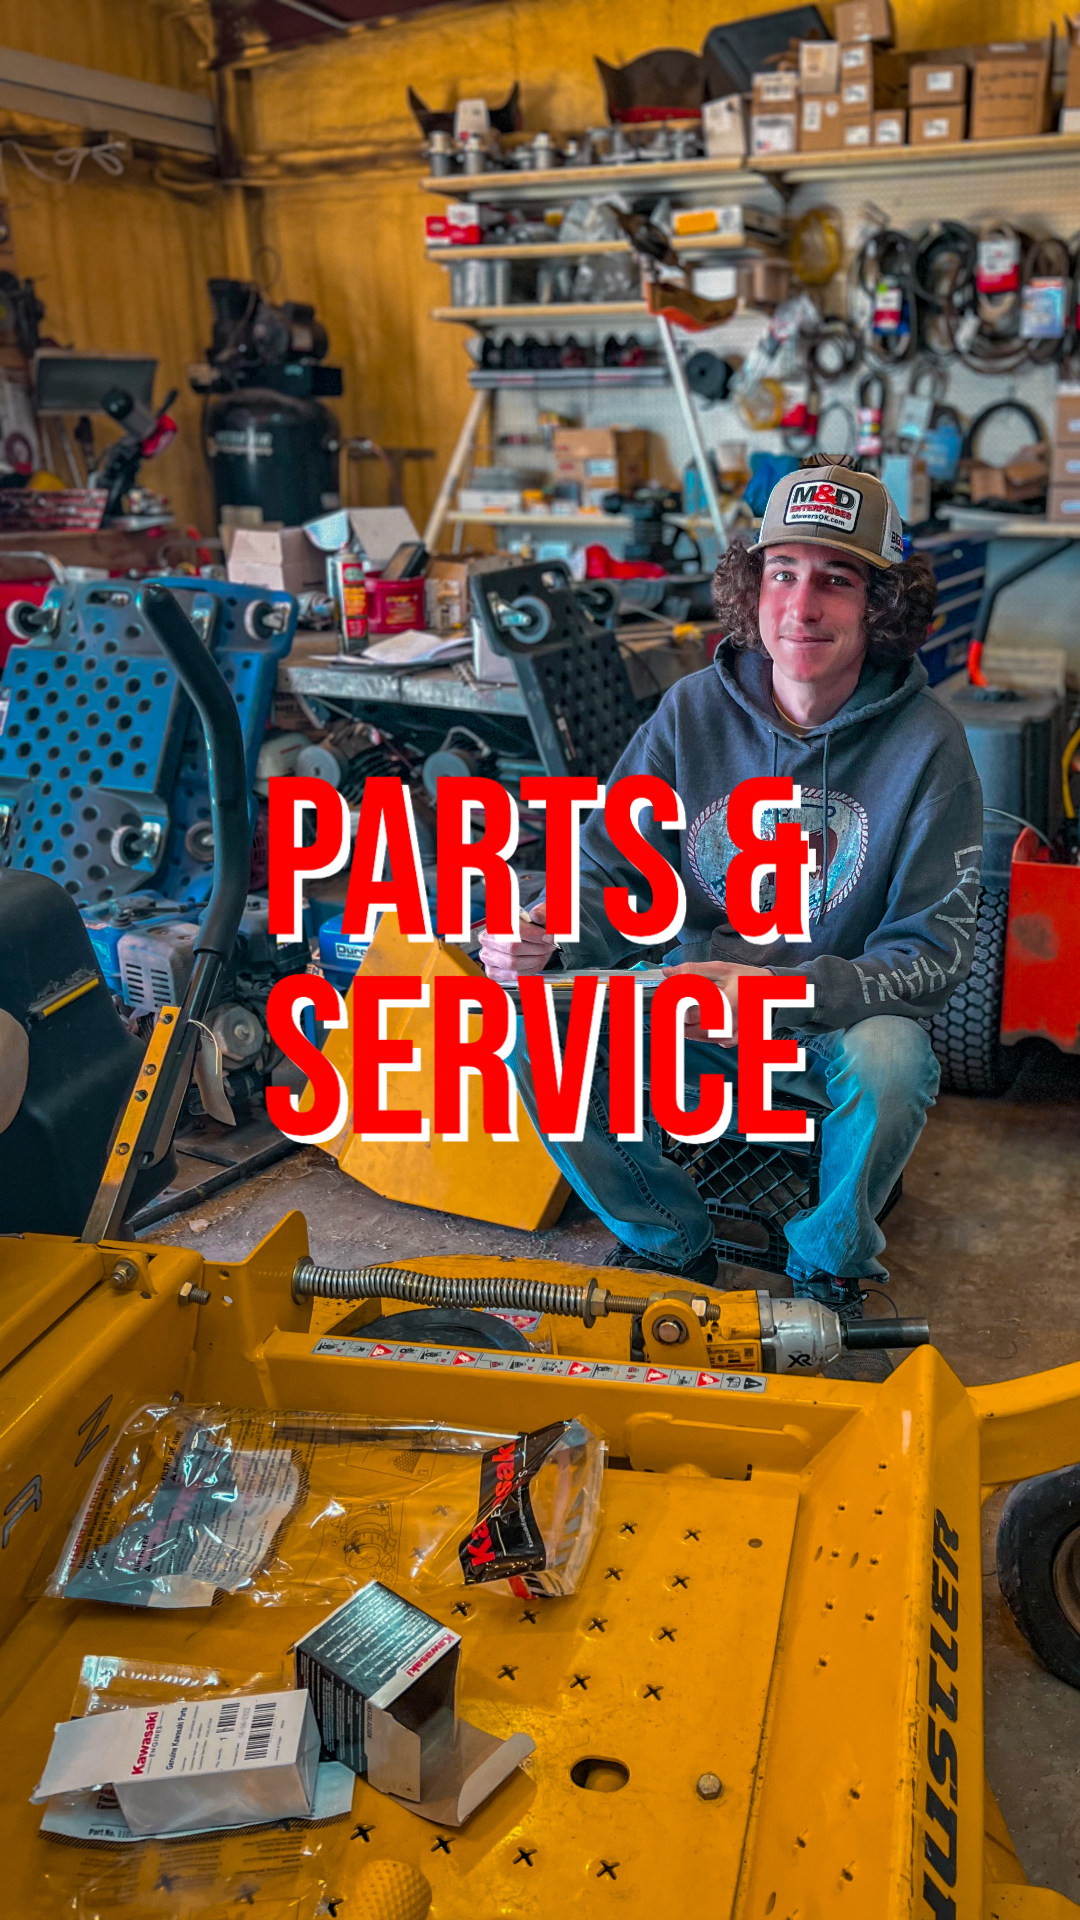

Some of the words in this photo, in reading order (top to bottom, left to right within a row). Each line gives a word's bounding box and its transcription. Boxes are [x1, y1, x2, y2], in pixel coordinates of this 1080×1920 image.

[793, 484, 856, 510] M&D
[789, 504, 852, 521] ENTERPRISES
[787, 1354, 813, 1368] XR
[159, 1456, 172, 1481] FILTRO
[178, 1707, 188, 1722] Parts
[131, 1711, 159, 1776] Kawasaki
[148, 1725, 163, 1758] ENGINES
[171, 1721, 184, 1747] Kawasaki
[166, 1746, 178, 1771] Genuine
